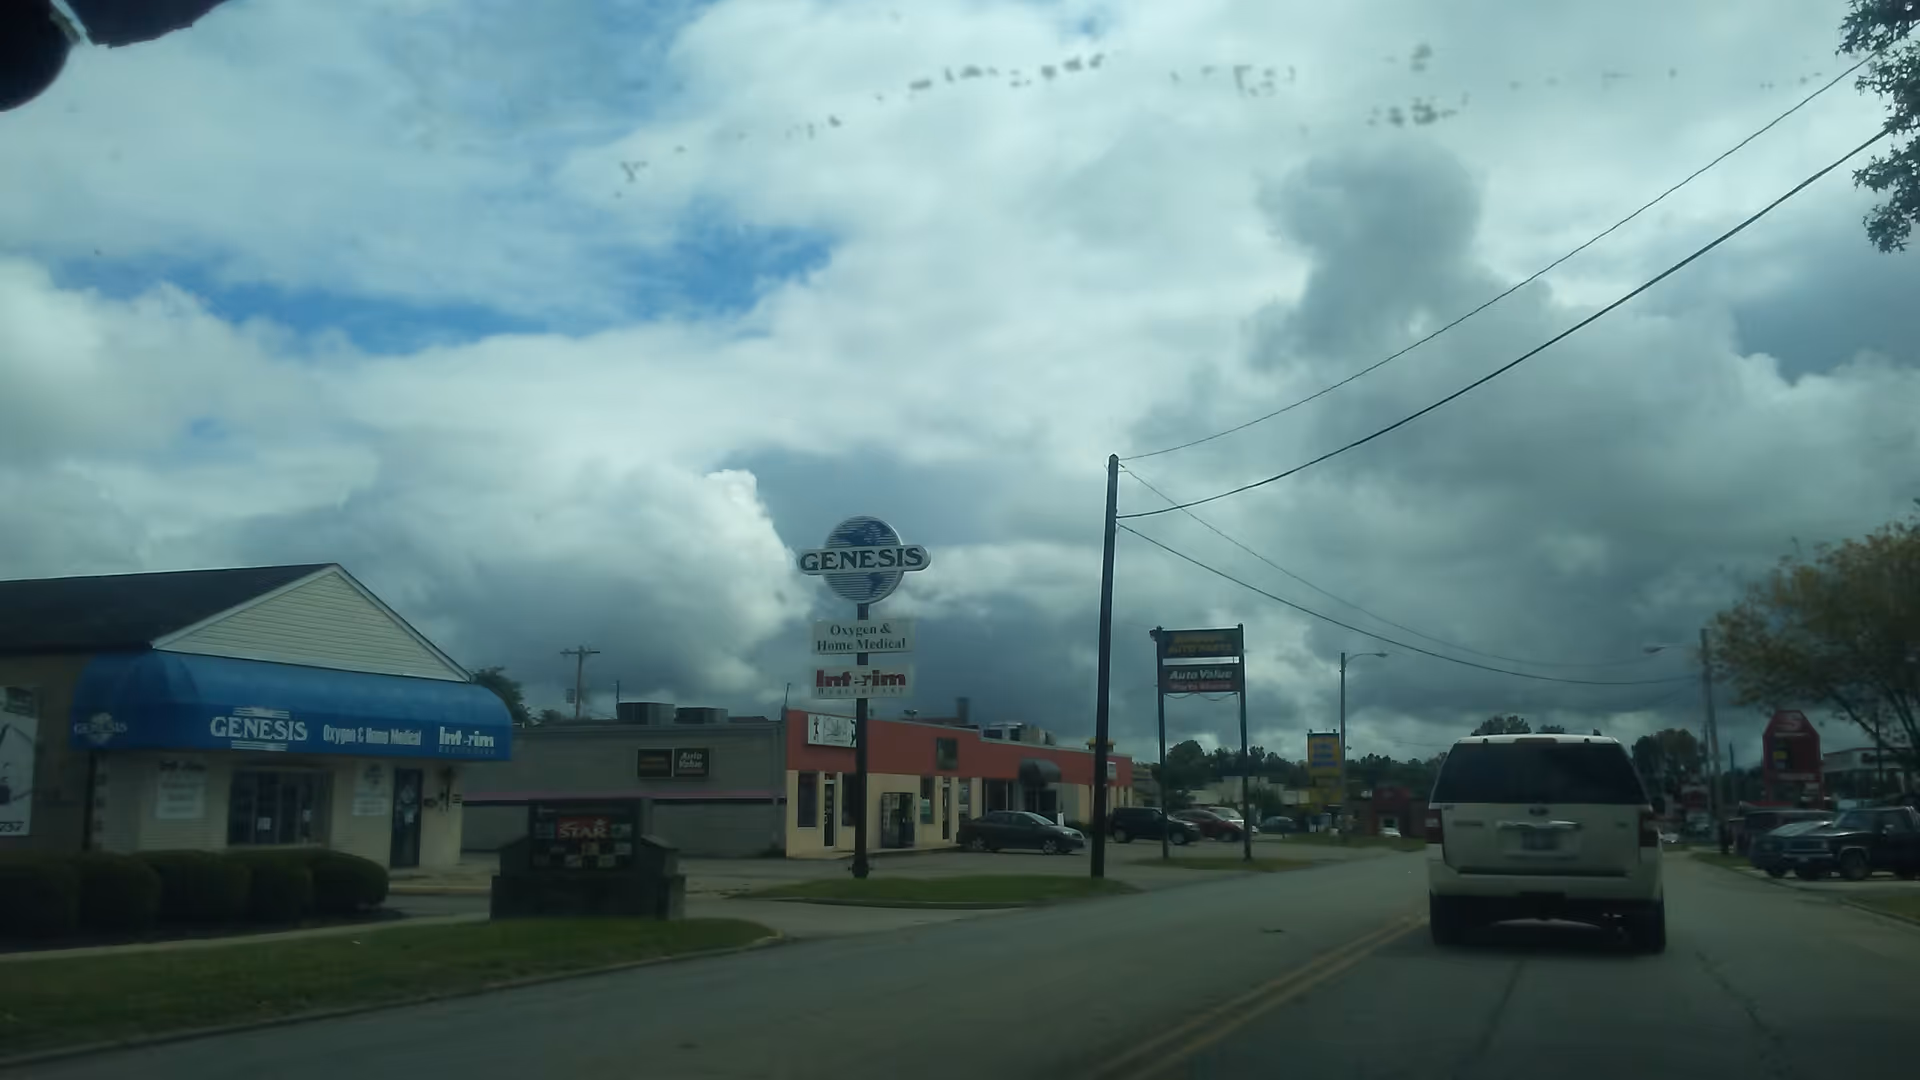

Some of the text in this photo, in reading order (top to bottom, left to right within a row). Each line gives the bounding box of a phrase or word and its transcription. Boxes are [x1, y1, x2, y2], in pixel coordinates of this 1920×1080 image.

[800, 548, 923, 571] GENESIS
[829, 622, 893, 638] Oxygen &
[816, 636, 906, 652] Home Medical
[1169, 669, 1233, 680] Auto Value
[209, 715, 308, 742] GENESIS
[679, 750, 703, 760] Auto
